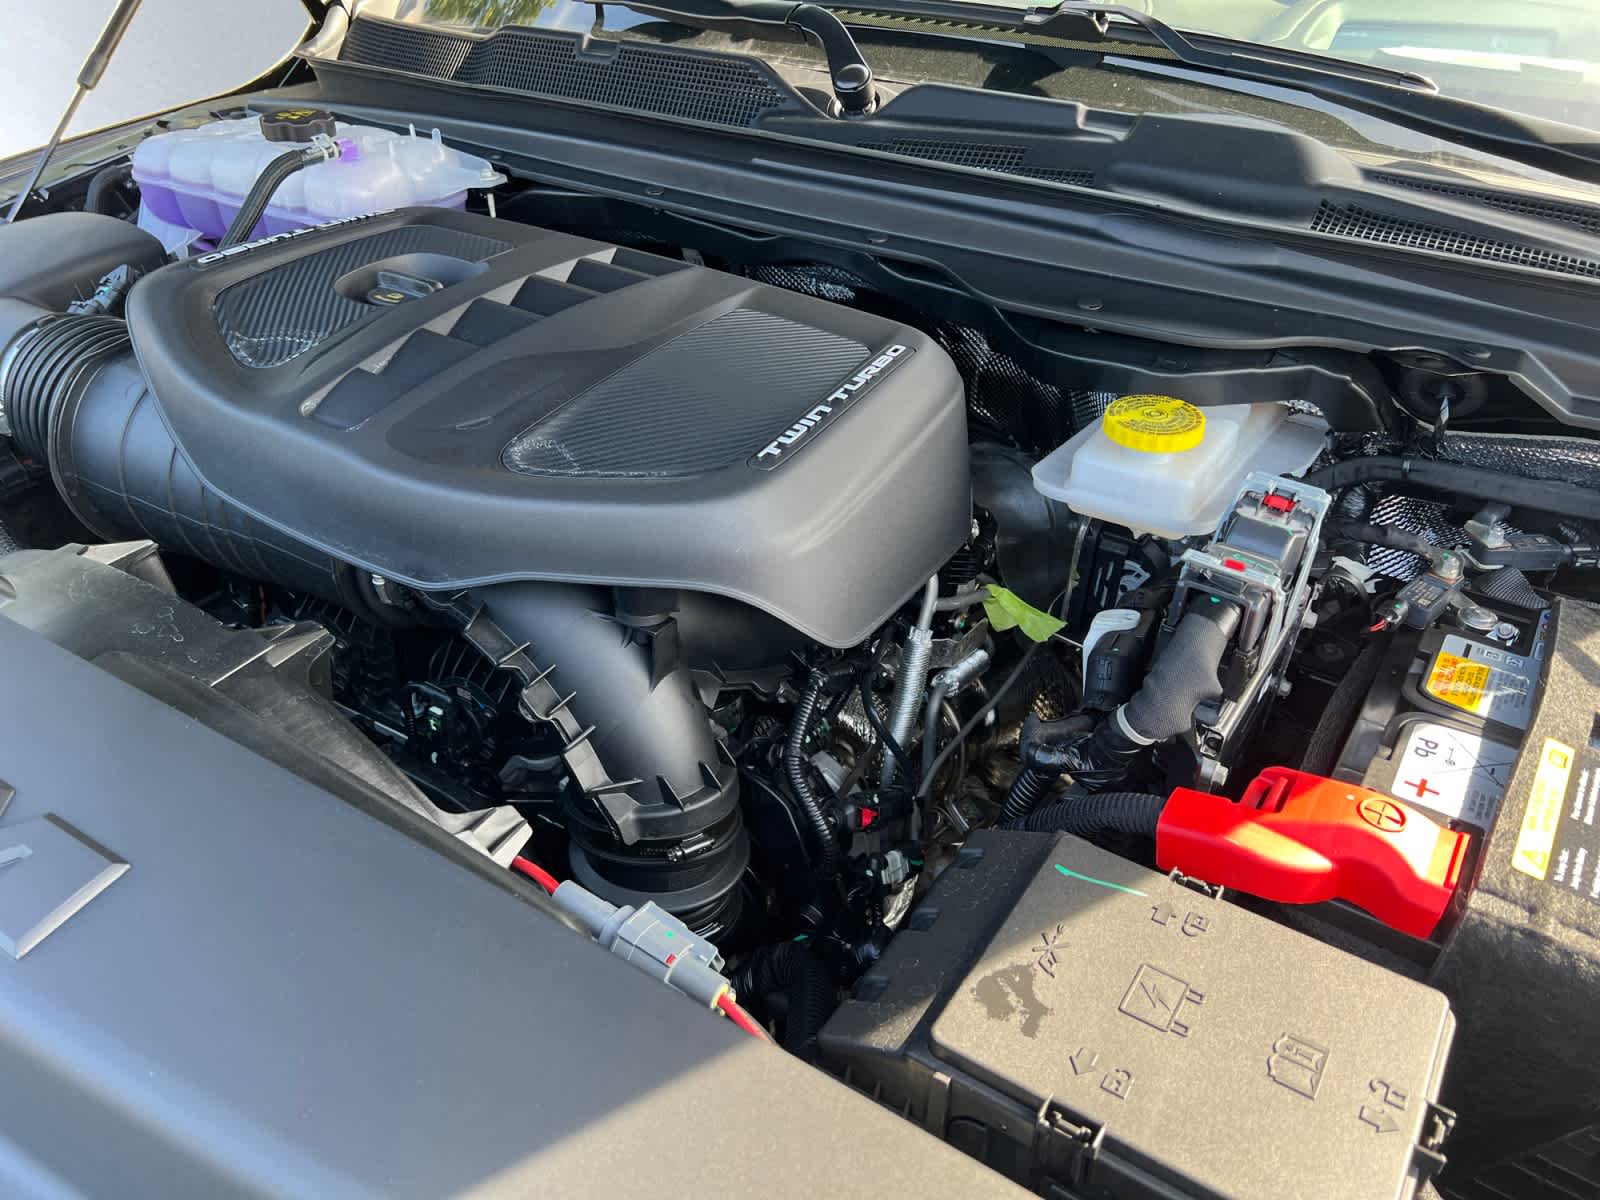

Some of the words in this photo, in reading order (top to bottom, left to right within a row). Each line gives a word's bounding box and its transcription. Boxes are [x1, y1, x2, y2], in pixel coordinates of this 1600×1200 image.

[757, 404, 833, 460] TWIN
[826, 344, 907, 402] TURBO
[1414, 736, 1439, 758] Pb
